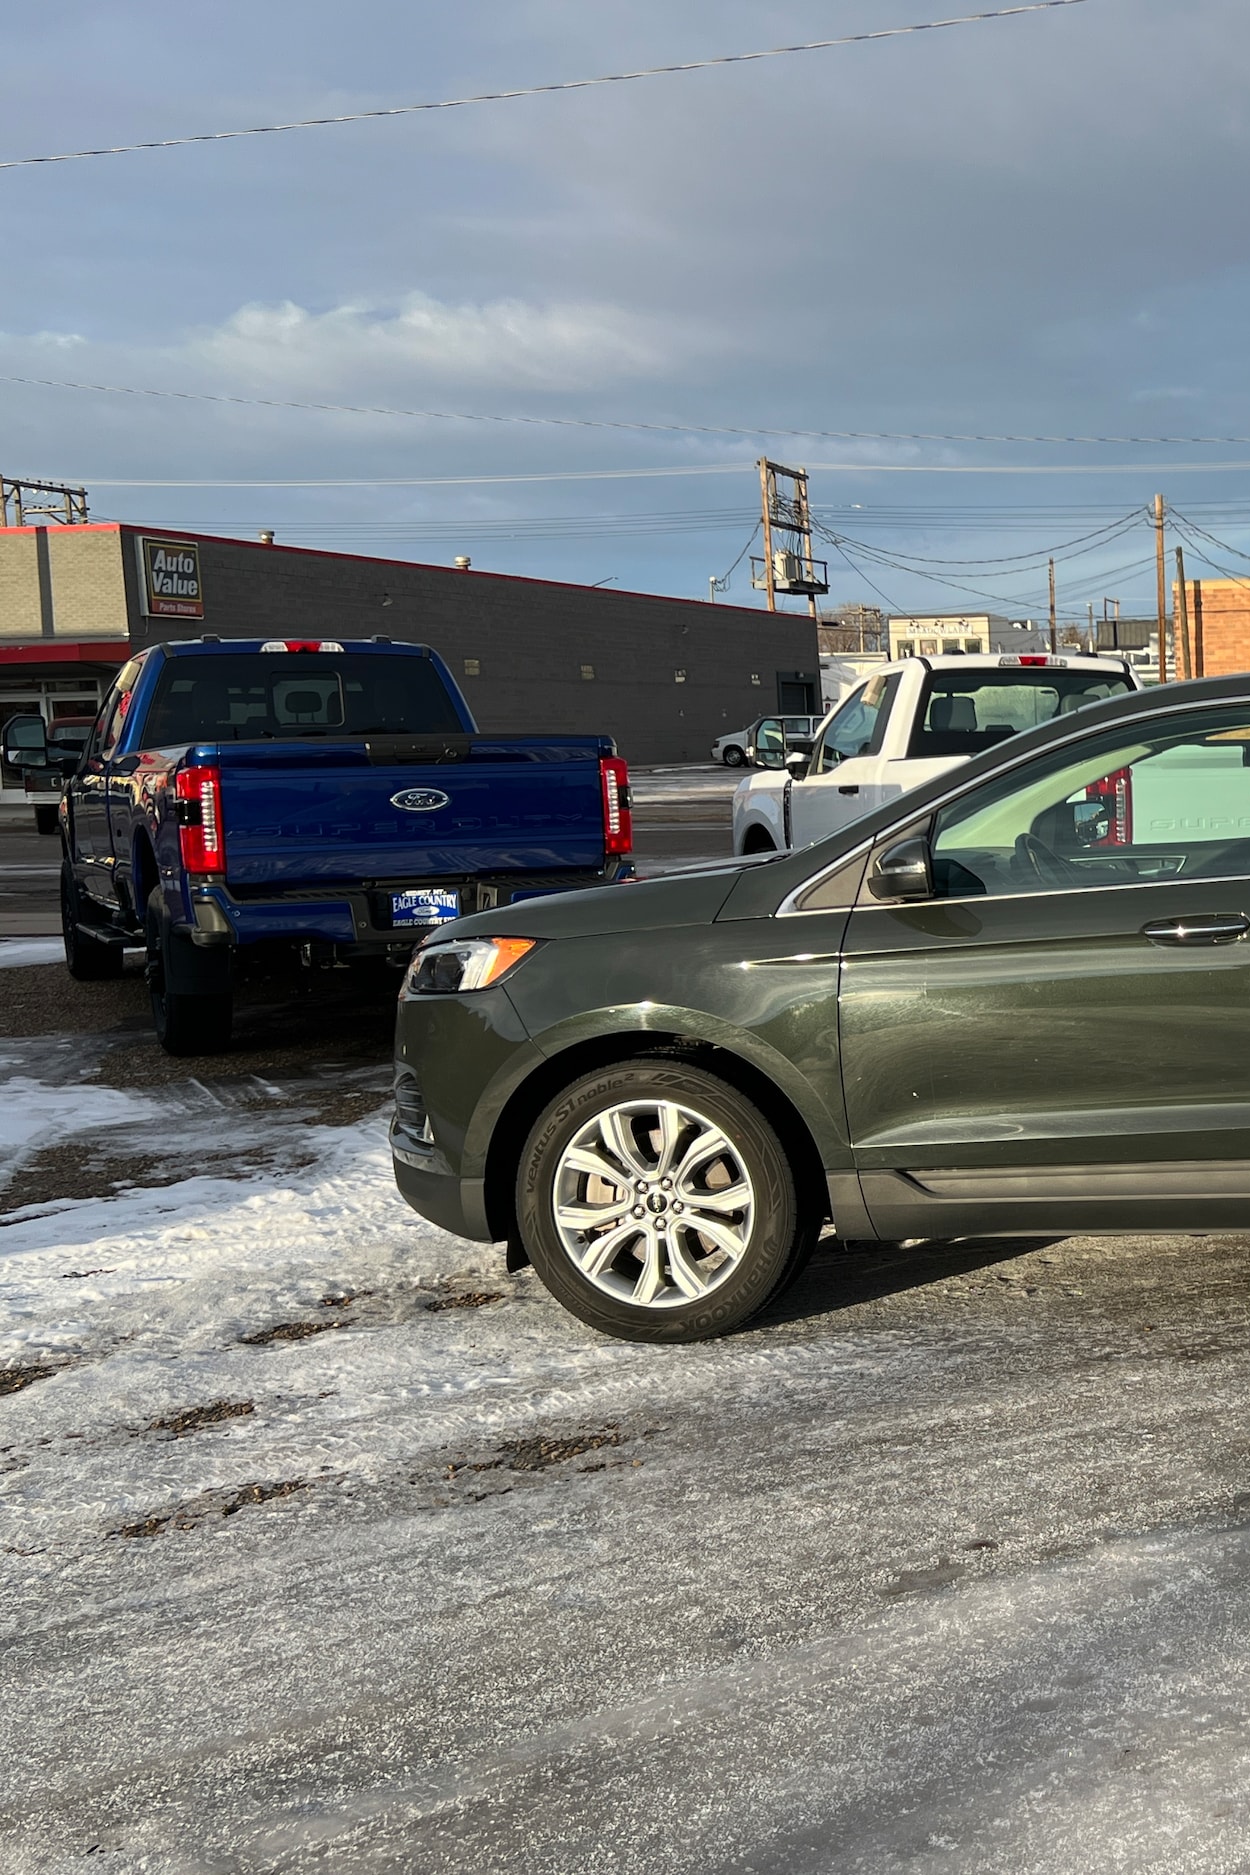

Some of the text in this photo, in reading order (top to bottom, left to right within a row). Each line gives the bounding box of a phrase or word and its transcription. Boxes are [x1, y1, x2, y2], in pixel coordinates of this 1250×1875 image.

[153, 549, 195, 573] Auto
[152, 571, 198, 595] Value
[255, 813, 583, 837] SUPER DUTY
[392, 894, 457, 913] EAGLE COUNTRY
[392, 918, 413, 927] EAGLE
